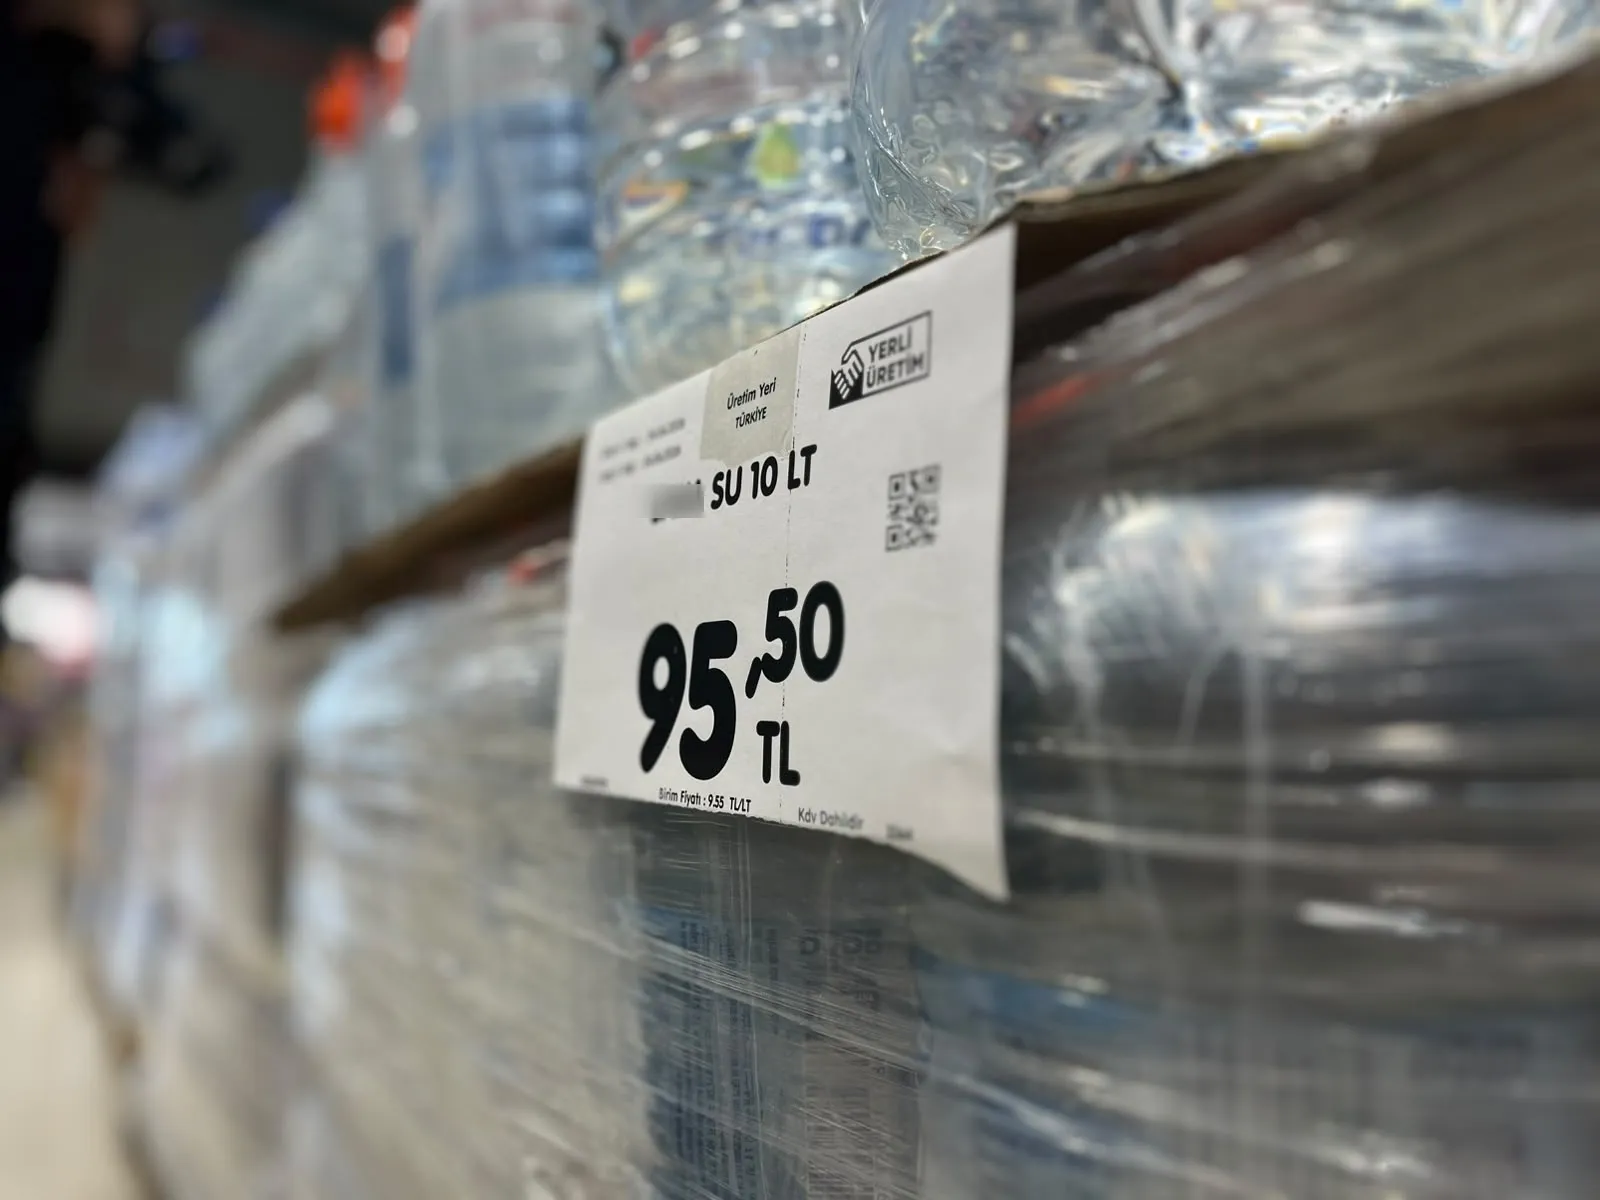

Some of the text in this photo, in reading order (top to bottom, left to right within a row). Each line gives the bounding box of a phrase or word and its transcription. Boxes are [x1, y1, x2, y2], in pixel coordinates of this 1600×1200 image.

[868, 324, 912, 363] YERLİ
[866, 352, 925, 389] ÜRETİM
[726, 376, 777, 410] Üretim Yeri
[735, 406, 767, 429] TÜRKİYE
[710, 465, 743, 510] SU
[750, 455, 779, 500] 10
[787, 443, 818, 490] LT
[756, 720, 801, 786] TL
[658, 786, 678, 802] Birim
[798, 807, 817, 824] Kdv
